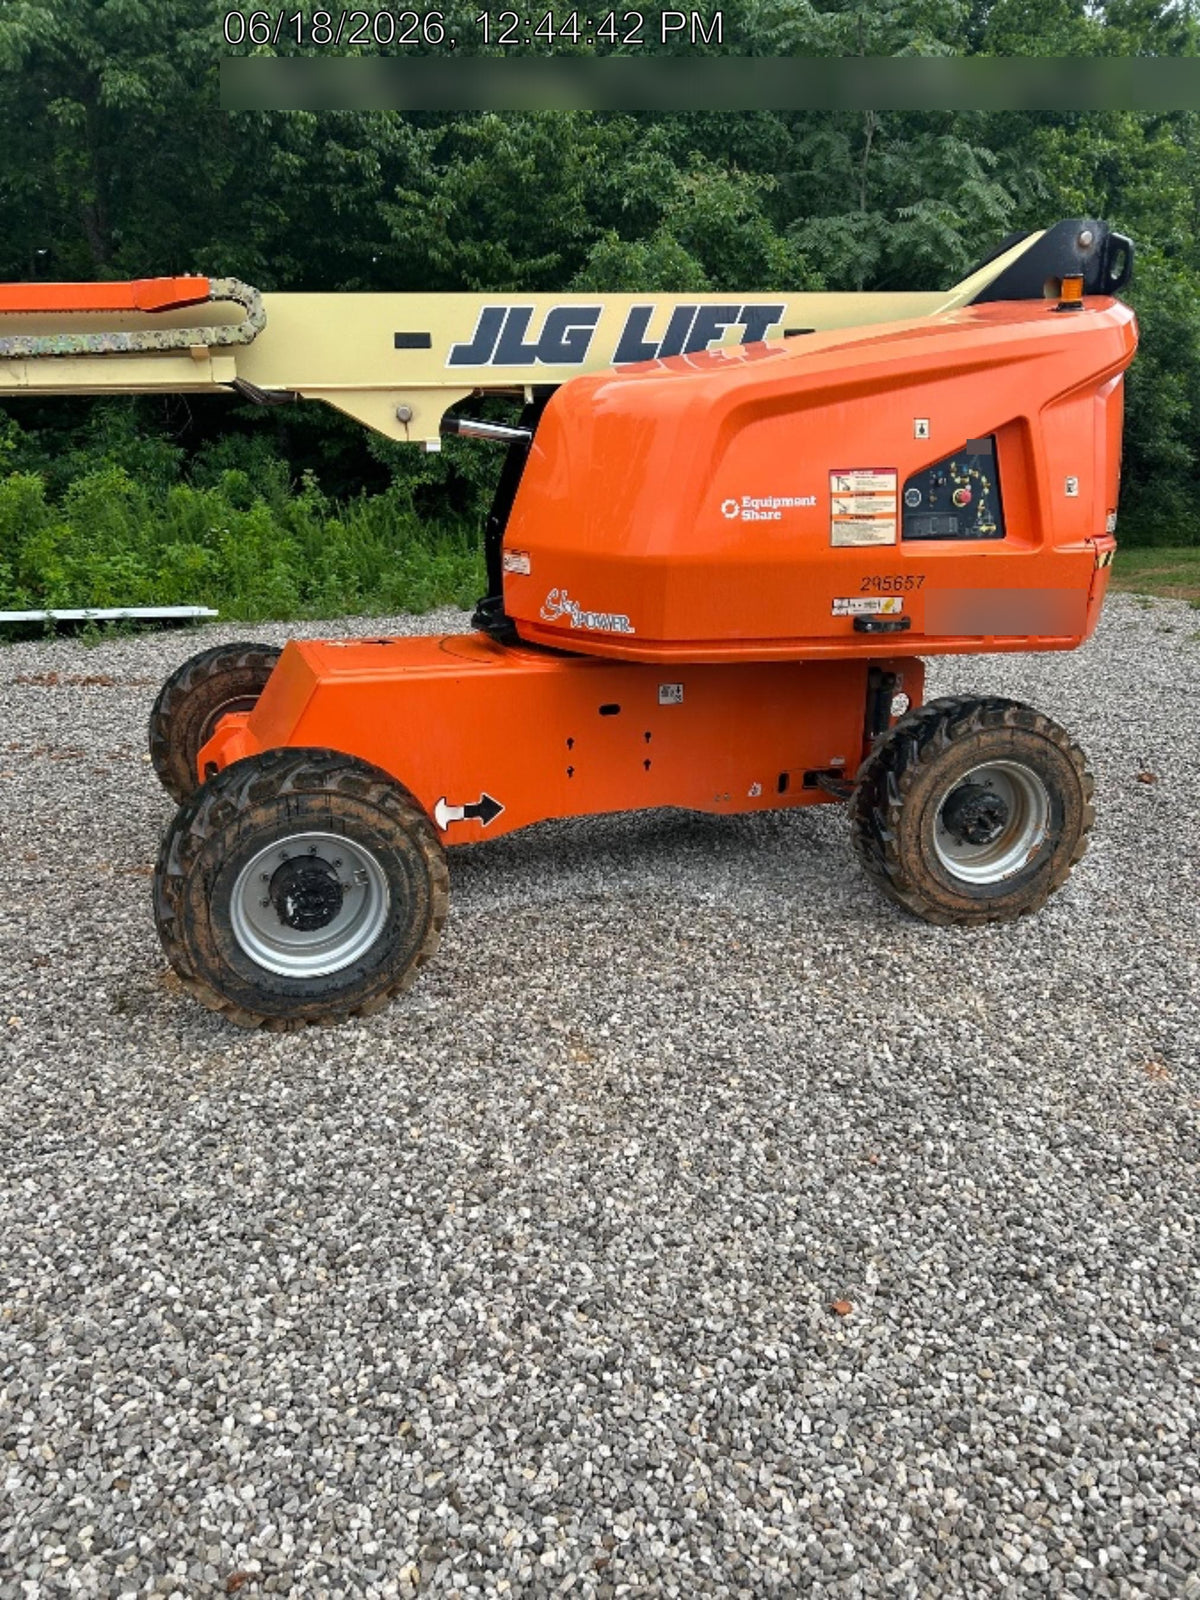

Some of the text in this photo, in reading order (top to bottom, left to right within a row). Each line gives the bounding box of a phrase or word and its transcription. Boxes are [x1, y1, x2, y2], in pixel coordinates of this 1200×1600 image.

[445, 304, 787, 368] JLG LIFT
[741, 496, 816, 509] Equipment
[741, 509, 782, 520] Share
[860, 575, 925, 591] 295657
